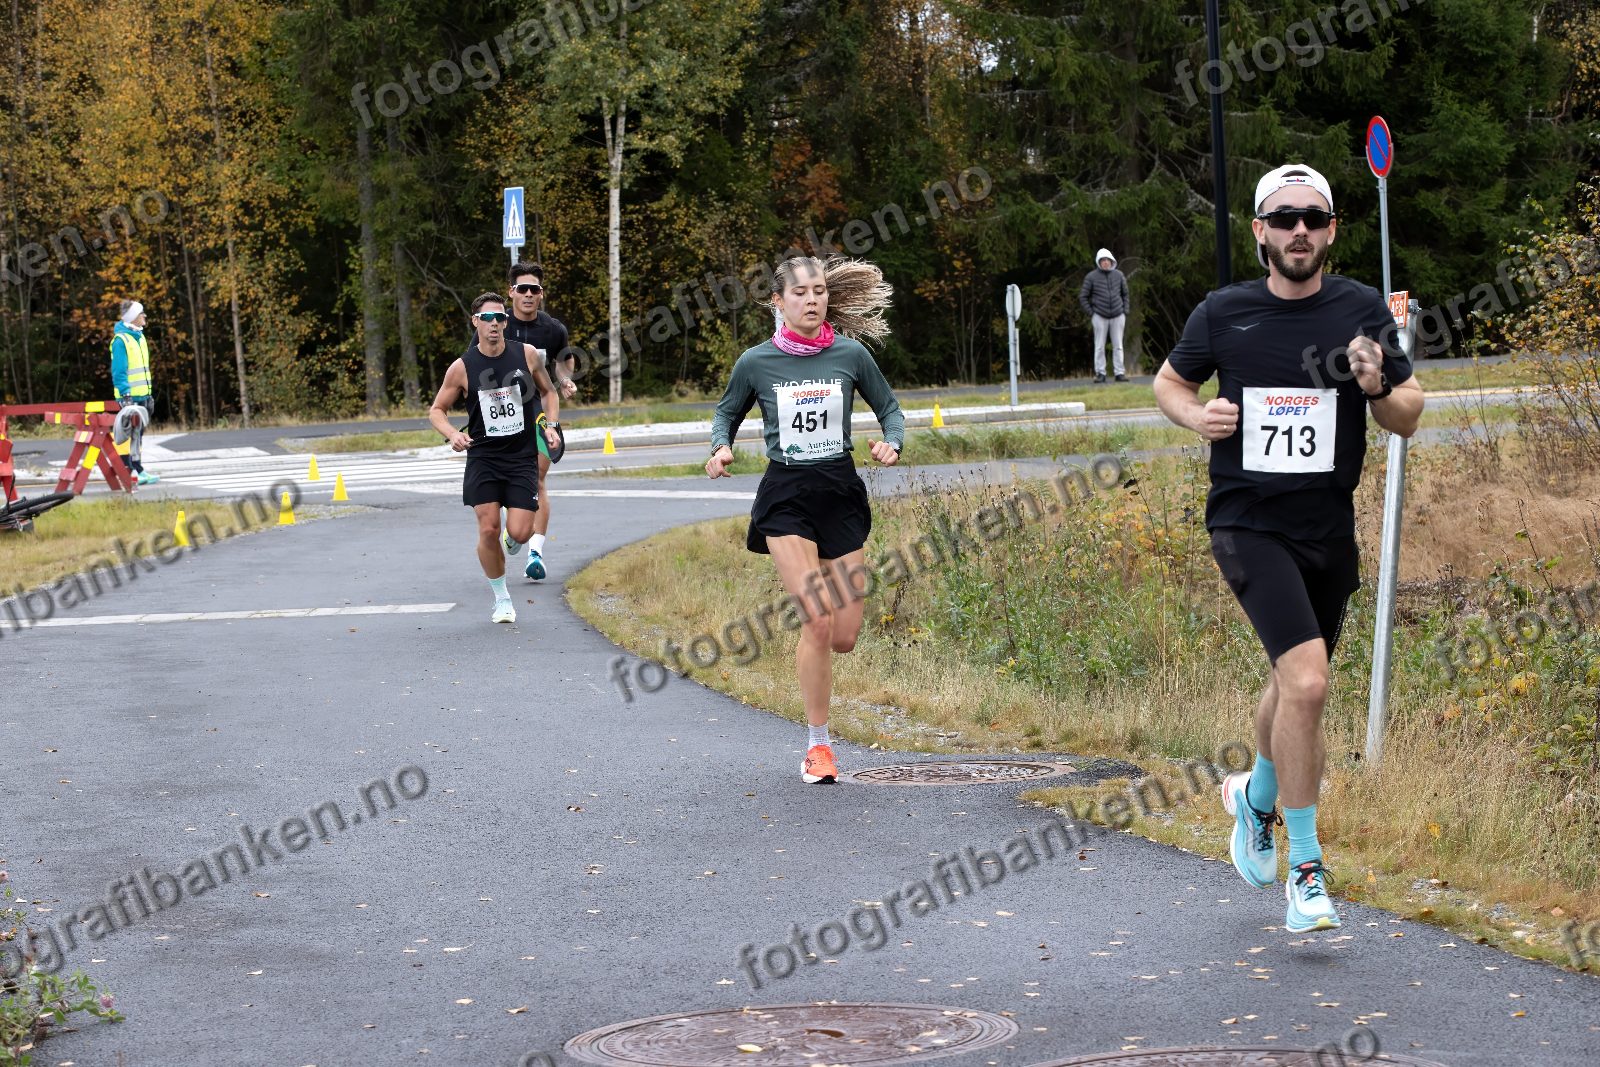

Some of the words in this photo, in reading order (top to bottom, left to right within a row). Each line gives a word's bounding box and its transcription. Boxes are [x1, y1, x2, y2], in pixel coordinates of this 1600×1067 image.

[790, 388, 831, 398] NORGES
[795, 396, 826, 406] LØPET
[1264, 396, 1320, 406] NORGES
[490, 403, 515, 419] 848
[1268, 406, 1310, 416] LØPET
[792, 410, 828, 433] 451
[1260, 425, 1317, 457] 713
